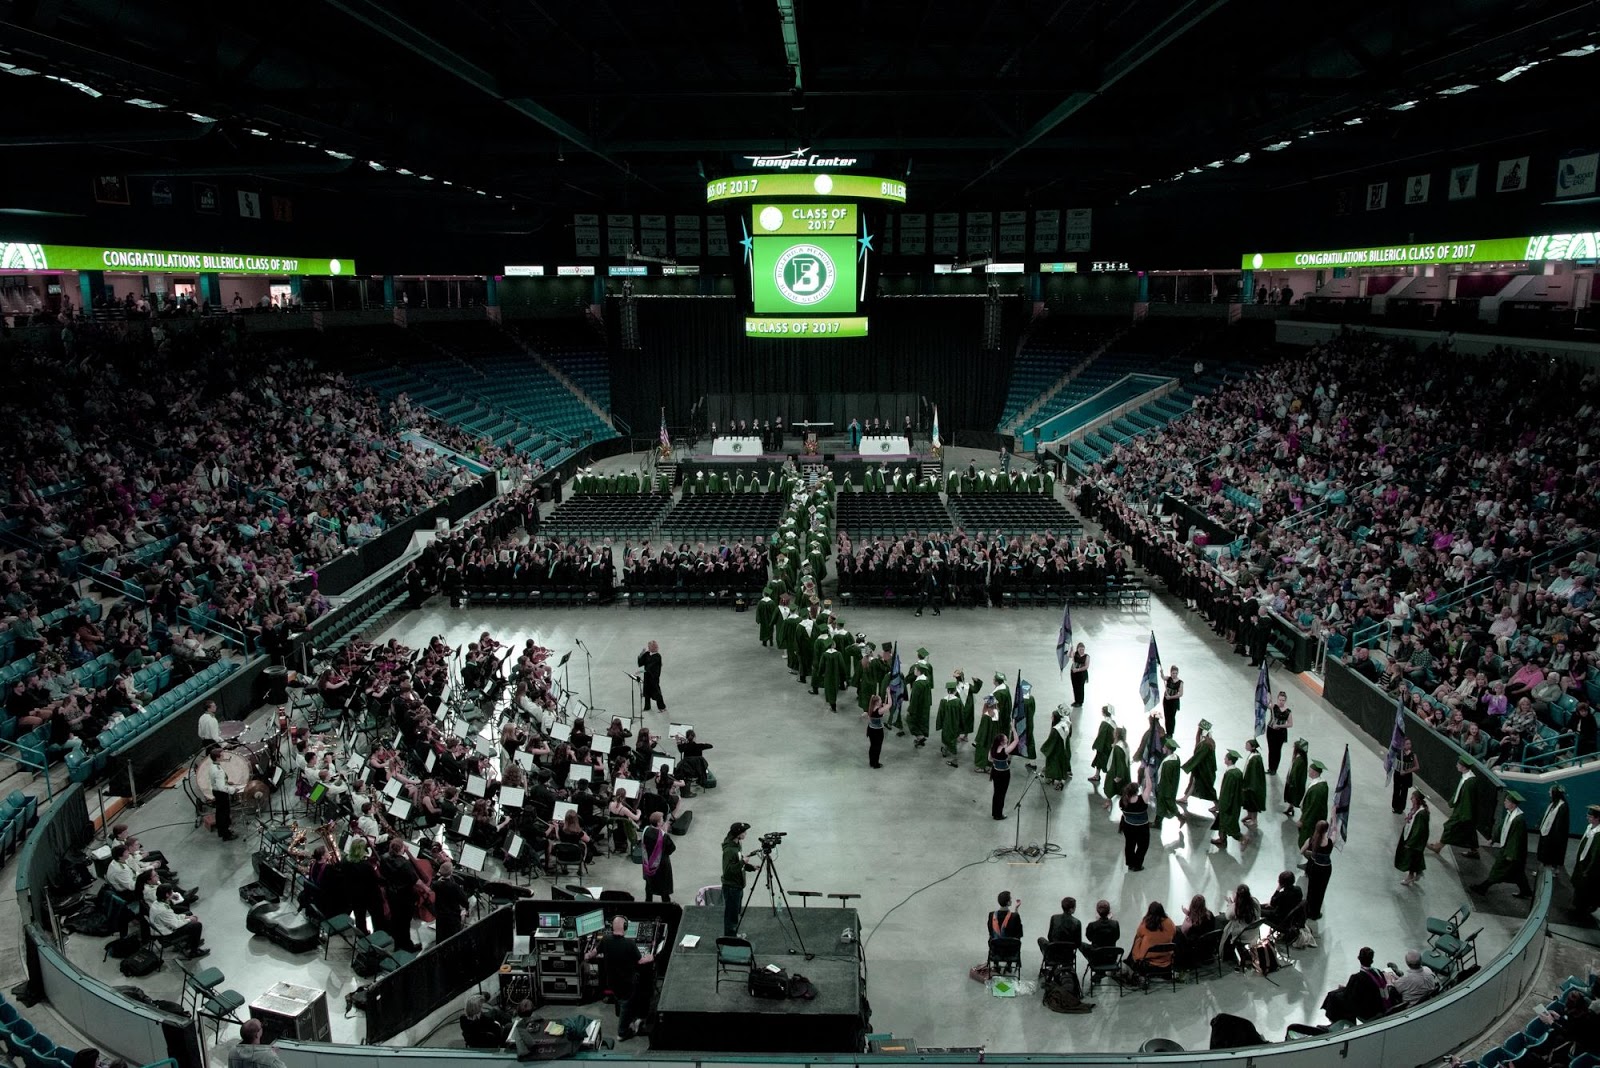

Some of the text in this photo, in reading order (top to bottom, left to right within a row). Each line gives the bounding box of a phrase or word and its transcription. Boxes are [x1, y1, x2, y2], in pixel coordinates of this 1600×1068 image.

[750, 154, 857, 169] Tsongas Center
[716, 182, 727, 195] OF
[730, 179, 758, 194] 2017
[792, 208, 848, 219] CLASS OF
[808, 220, 836, 230] 2017
[103, 250, 298, 271] CONGRATULATIONS BILLERICA CLASS OF 2017
[777, 247, 833, 278] BILLERICA MEMORIAL
[1295, 243, 1476, 266] CONGRATULATIONS BILLERICA CLASS OF 2017
[792, 257, 819, 292] B
[758, 322, 789, 333] CLASS
[792, 322, 809, 333] OF
[812, 322, 841, 333] 2017
